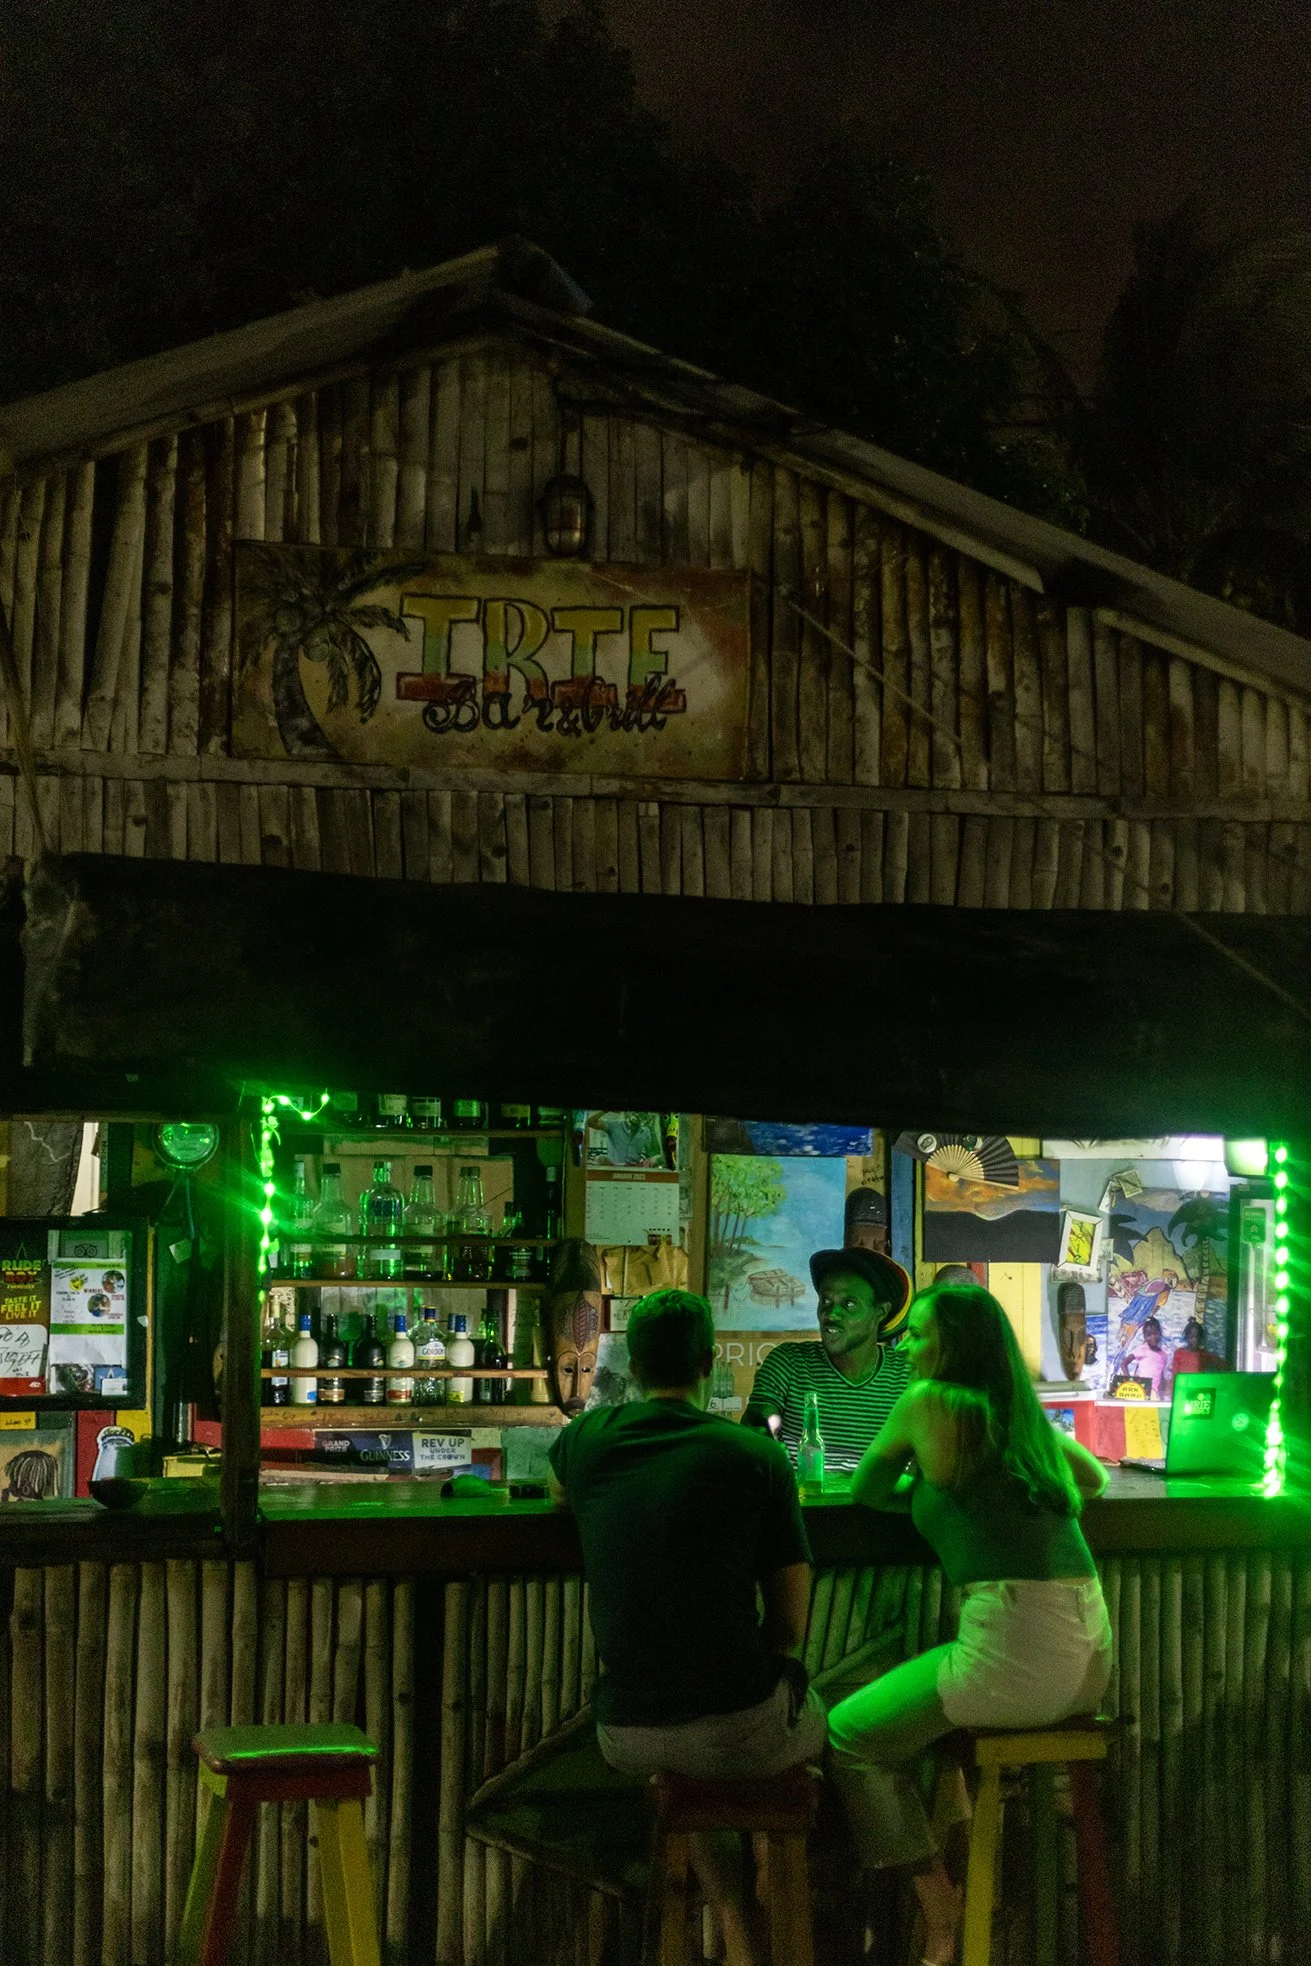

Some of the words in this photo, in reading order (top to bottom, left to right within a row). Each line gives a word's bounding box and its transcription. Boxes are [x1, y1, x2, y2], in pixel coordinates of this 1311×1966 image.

[396, 593, 686, 714] IRIE
[1, 1259, 42, 1272] RUDE
[4, 1296, 28, 1305] TASTE
[1, 1303, 27, 1314] FEEL
[30, 1301, 42, 1311] IT
[5, 1311, 26, 1320] LIVE
[28, 1310, 37, 1318] IT
[322, 1440, 351, 1448] GRAND
[421, 1438, 445, 1448] REV
[448, 1438, 465, 1447] UP
[360, 1449, 410, 1462] GUINNESS
